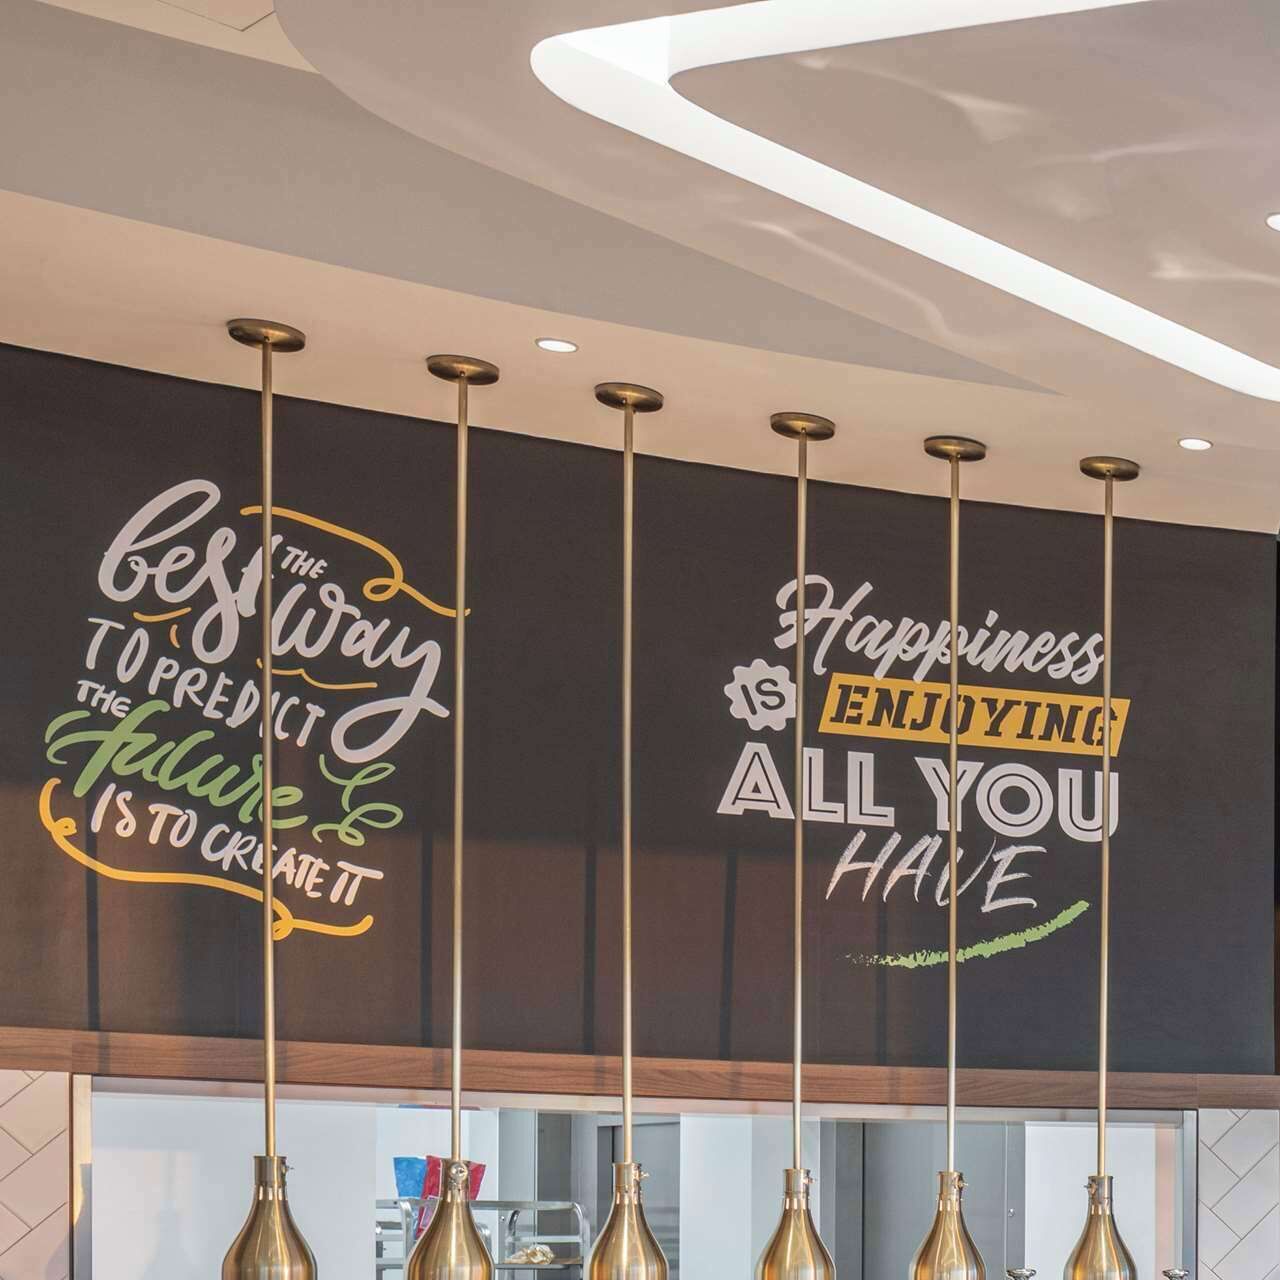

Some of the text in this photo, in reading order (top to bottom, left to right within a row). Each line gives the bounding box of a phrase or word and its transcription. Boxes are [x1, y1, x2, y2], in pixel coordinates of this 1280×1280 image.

[98, 479, 450, 763] best THE way
[774, 573, 1105, 685] Happiness
[77, 680, 130, 718] THE
[85, 617, 325, 748] TO PREDICT
[740, 678, 787, 717] IS
[830, 683, 1119, 747] ENJOYING
[46, 700, 308, 828] future
[716, 741, 1119, 843] ALL YOU
[90, 783, 384, 906] IS TO CREATE IT
[825, 829, 1047, 913] HAVE
